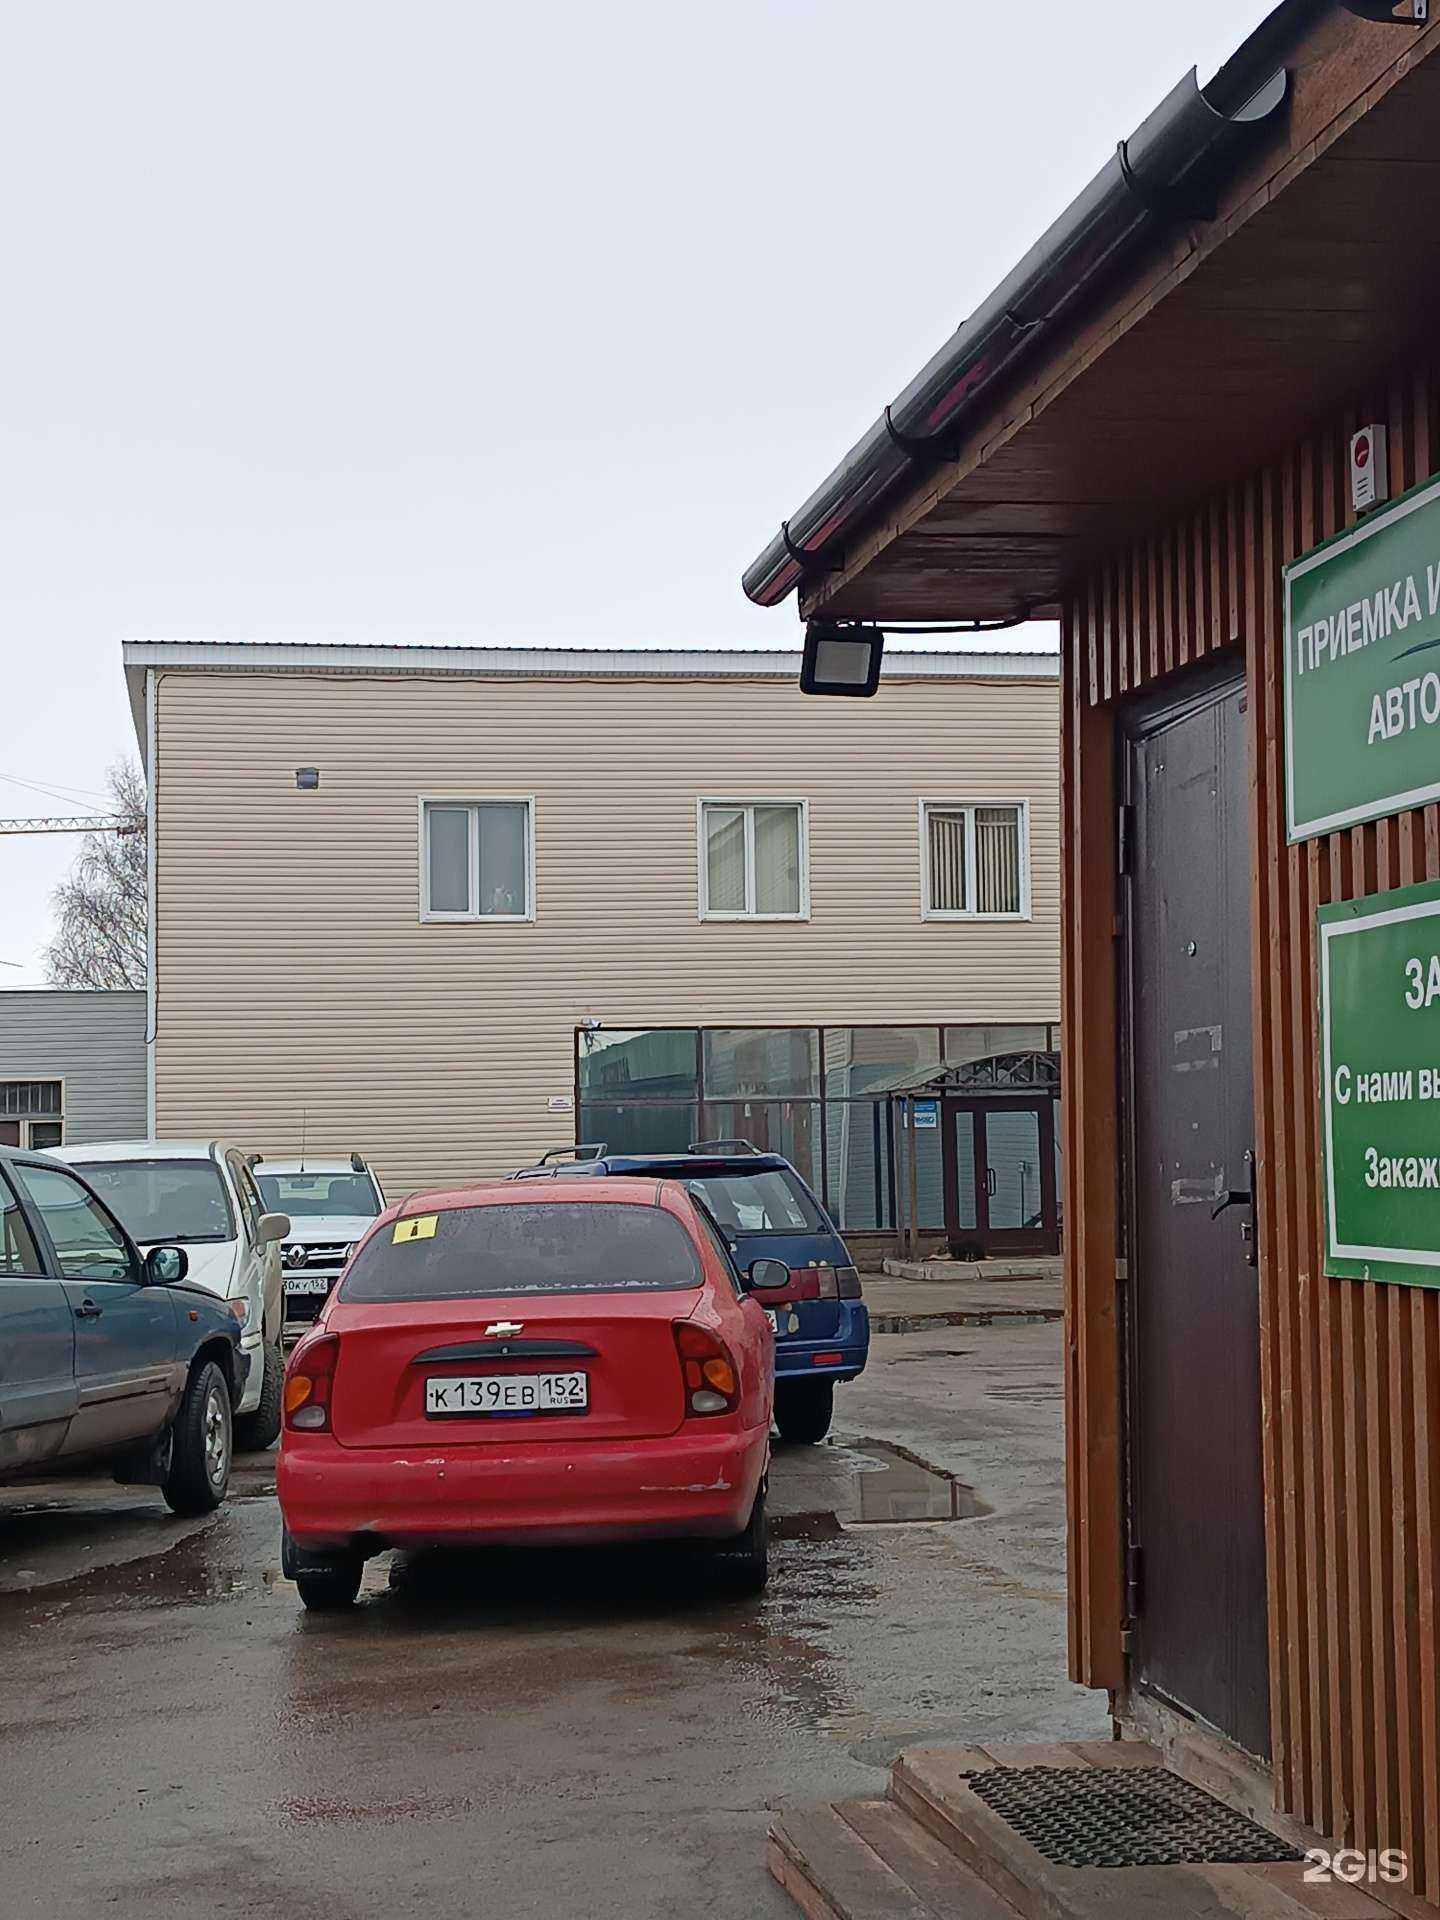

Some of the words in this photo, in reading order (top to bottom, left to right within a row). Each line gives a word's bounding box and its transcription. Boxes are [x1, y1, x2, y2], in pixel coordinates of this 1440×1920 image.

[1297, 575, 1422, 675] ПРИЕМКА
[1334, 1065, 1351, 1105] С
[1356, 1070, 1412, 1104] нами
[1364, 1146, 1440, 1188] Закаж
[434, 1381, 535, 1408] К139ЕВ
[542, 1377, 580, 1396] 152
